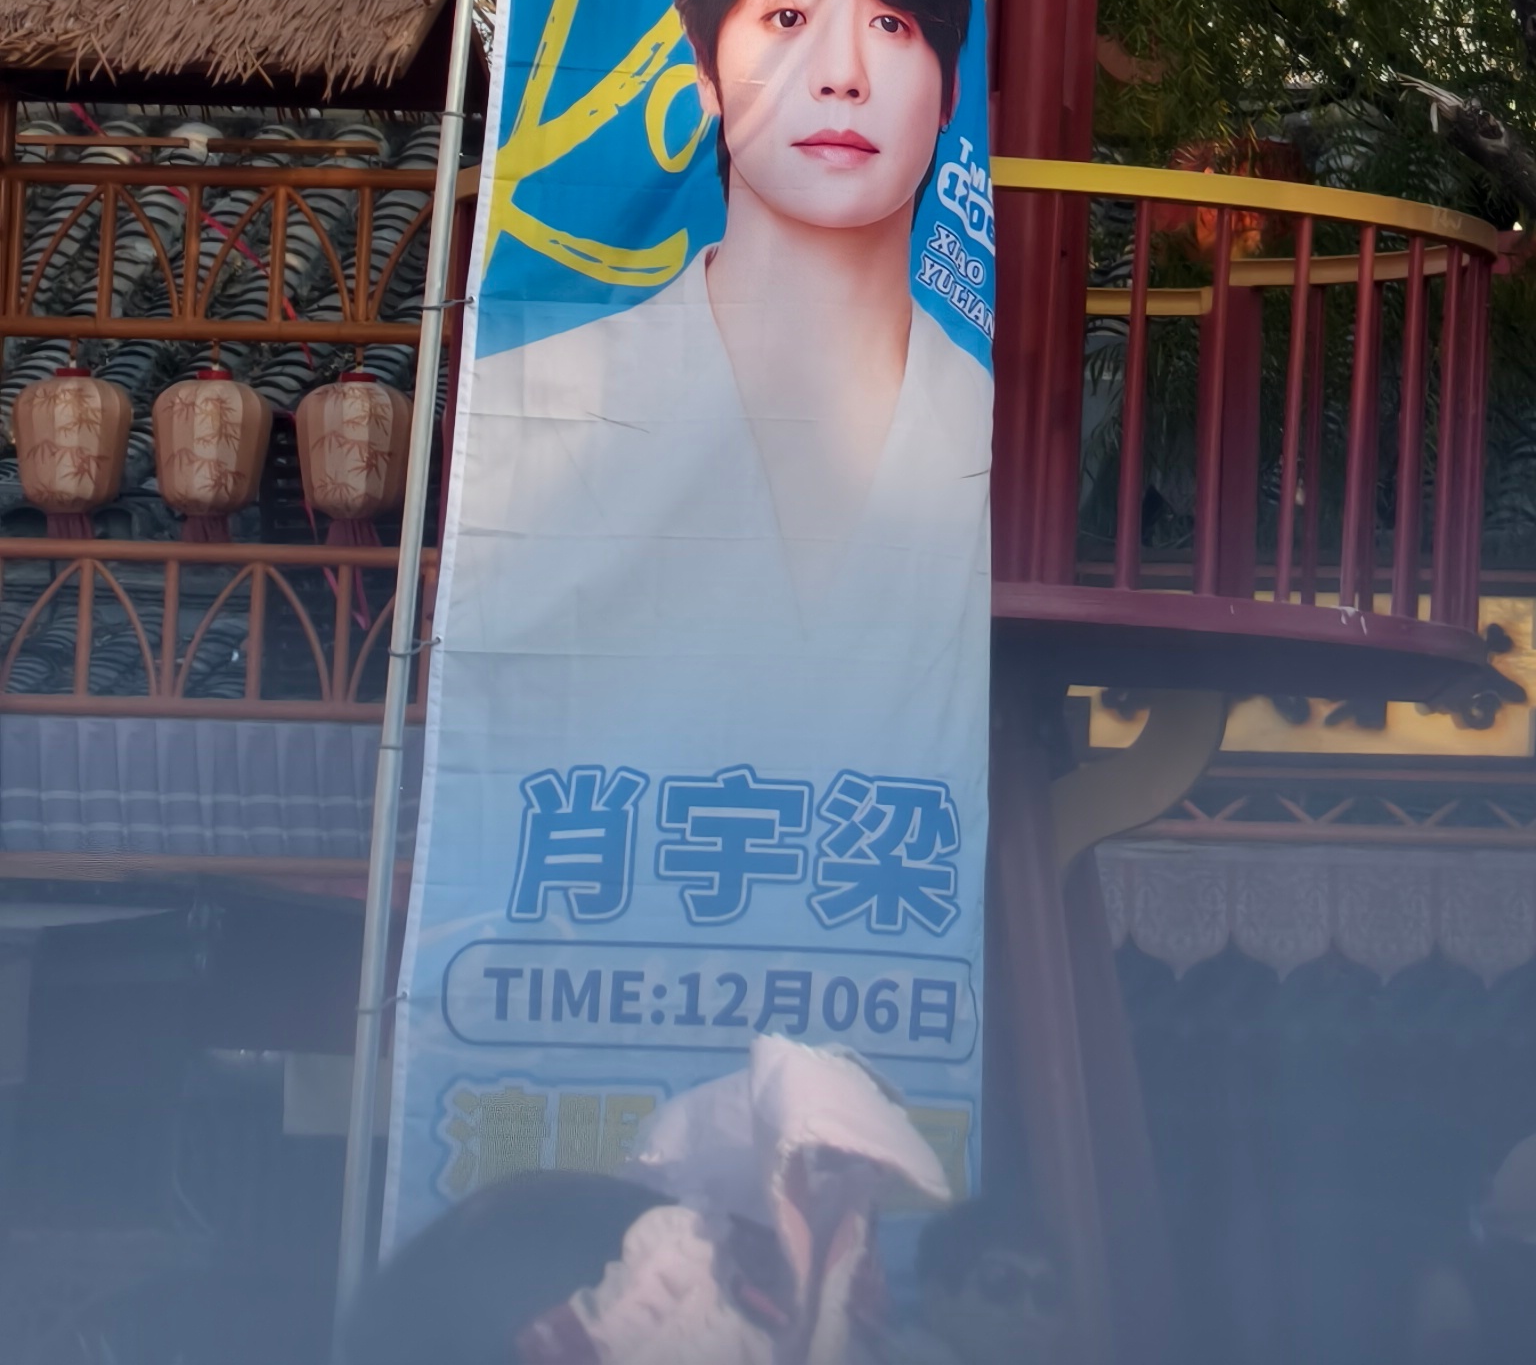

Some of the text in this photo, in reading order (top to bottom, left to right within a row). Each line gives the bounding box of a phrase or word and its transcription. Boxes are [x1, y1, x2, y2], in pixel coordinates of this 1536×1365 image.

[928, 223, 985, 286] XIAO
[507, 764, 961, 936] 肖宇梁
[483, 965, 957, 1043] TIME:12月06日
